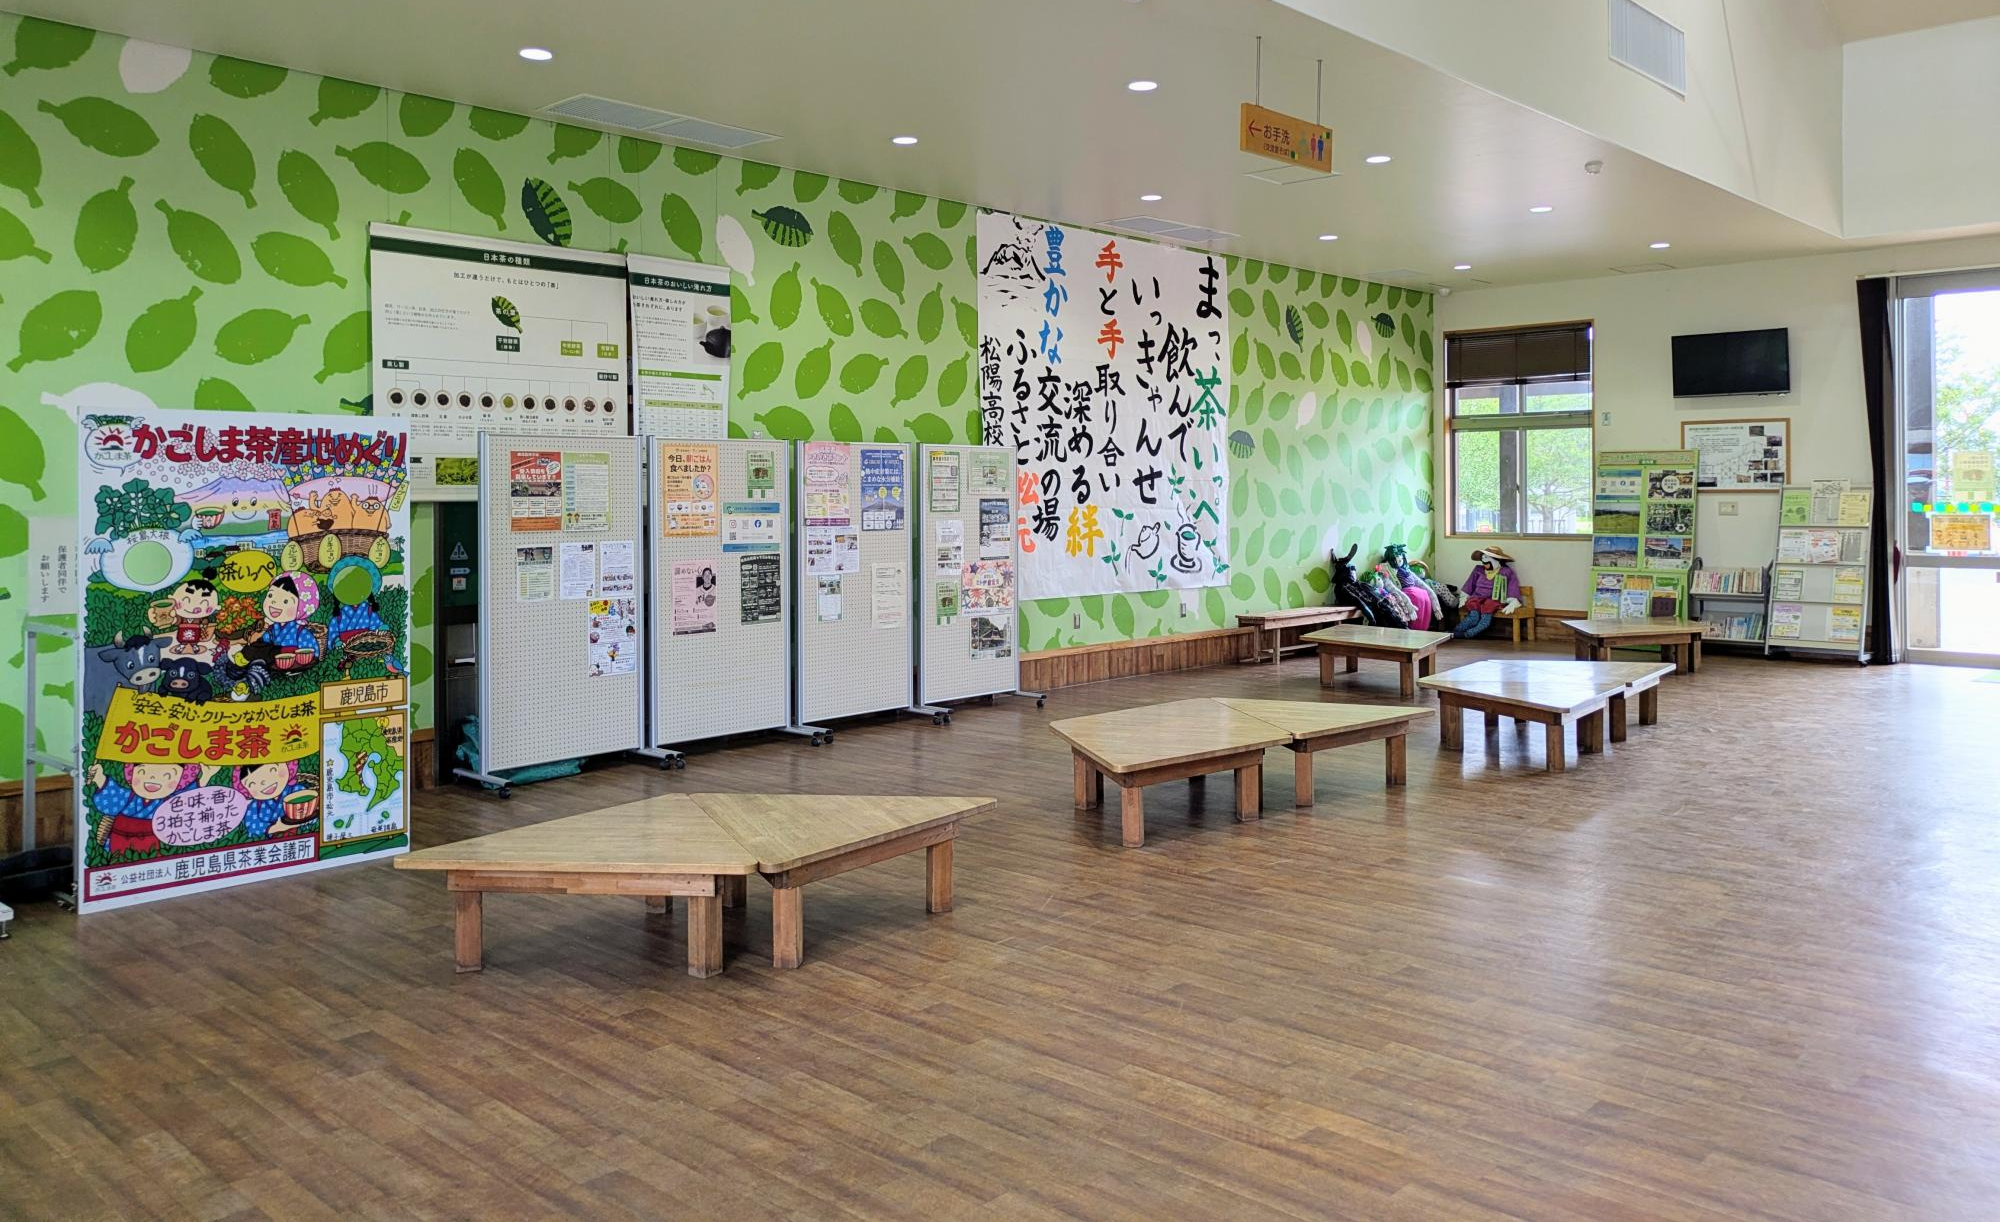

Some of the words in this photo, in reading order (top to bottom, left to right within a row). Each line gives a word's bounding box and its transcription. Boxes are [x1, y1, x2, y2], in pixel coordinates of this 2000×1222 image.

[1263, 123, 1290, 145] お手洗
[483, 252, 531, 266] 日本茶の種類
[644, 277, 712, 292] 日本茶のおいしい淹れ方
[1032, 225, 1068, 541] 豊かな交流の場
[1094, 239, 1126, 493] 手と手取り合い
[980, 335, 1004, 446] 松陽高校
[1131, 276, 1163, 505] いっきゃんせ
[1157, 322, 1197, 462] 飲んで
[131, 423, 408, 468] かごしま茶産地めぐり
[1063, 379, 1105, 558] 深める絆
[40, 554, 50, 603] お願いします
[58, 545, 67, 594] 保護者同伴で
[220, 561, 276, 582] 茶いっぺ
[340, 682, 389, 706] 鹿児島市
[114, 721, 271, 760] かごしま茶
[166, 820, 232, 845] かごしま茶
[120, 867, 172, 885] 公益社団法人
[174, 839, 312, 880] 鹿児島県茶業会議所
